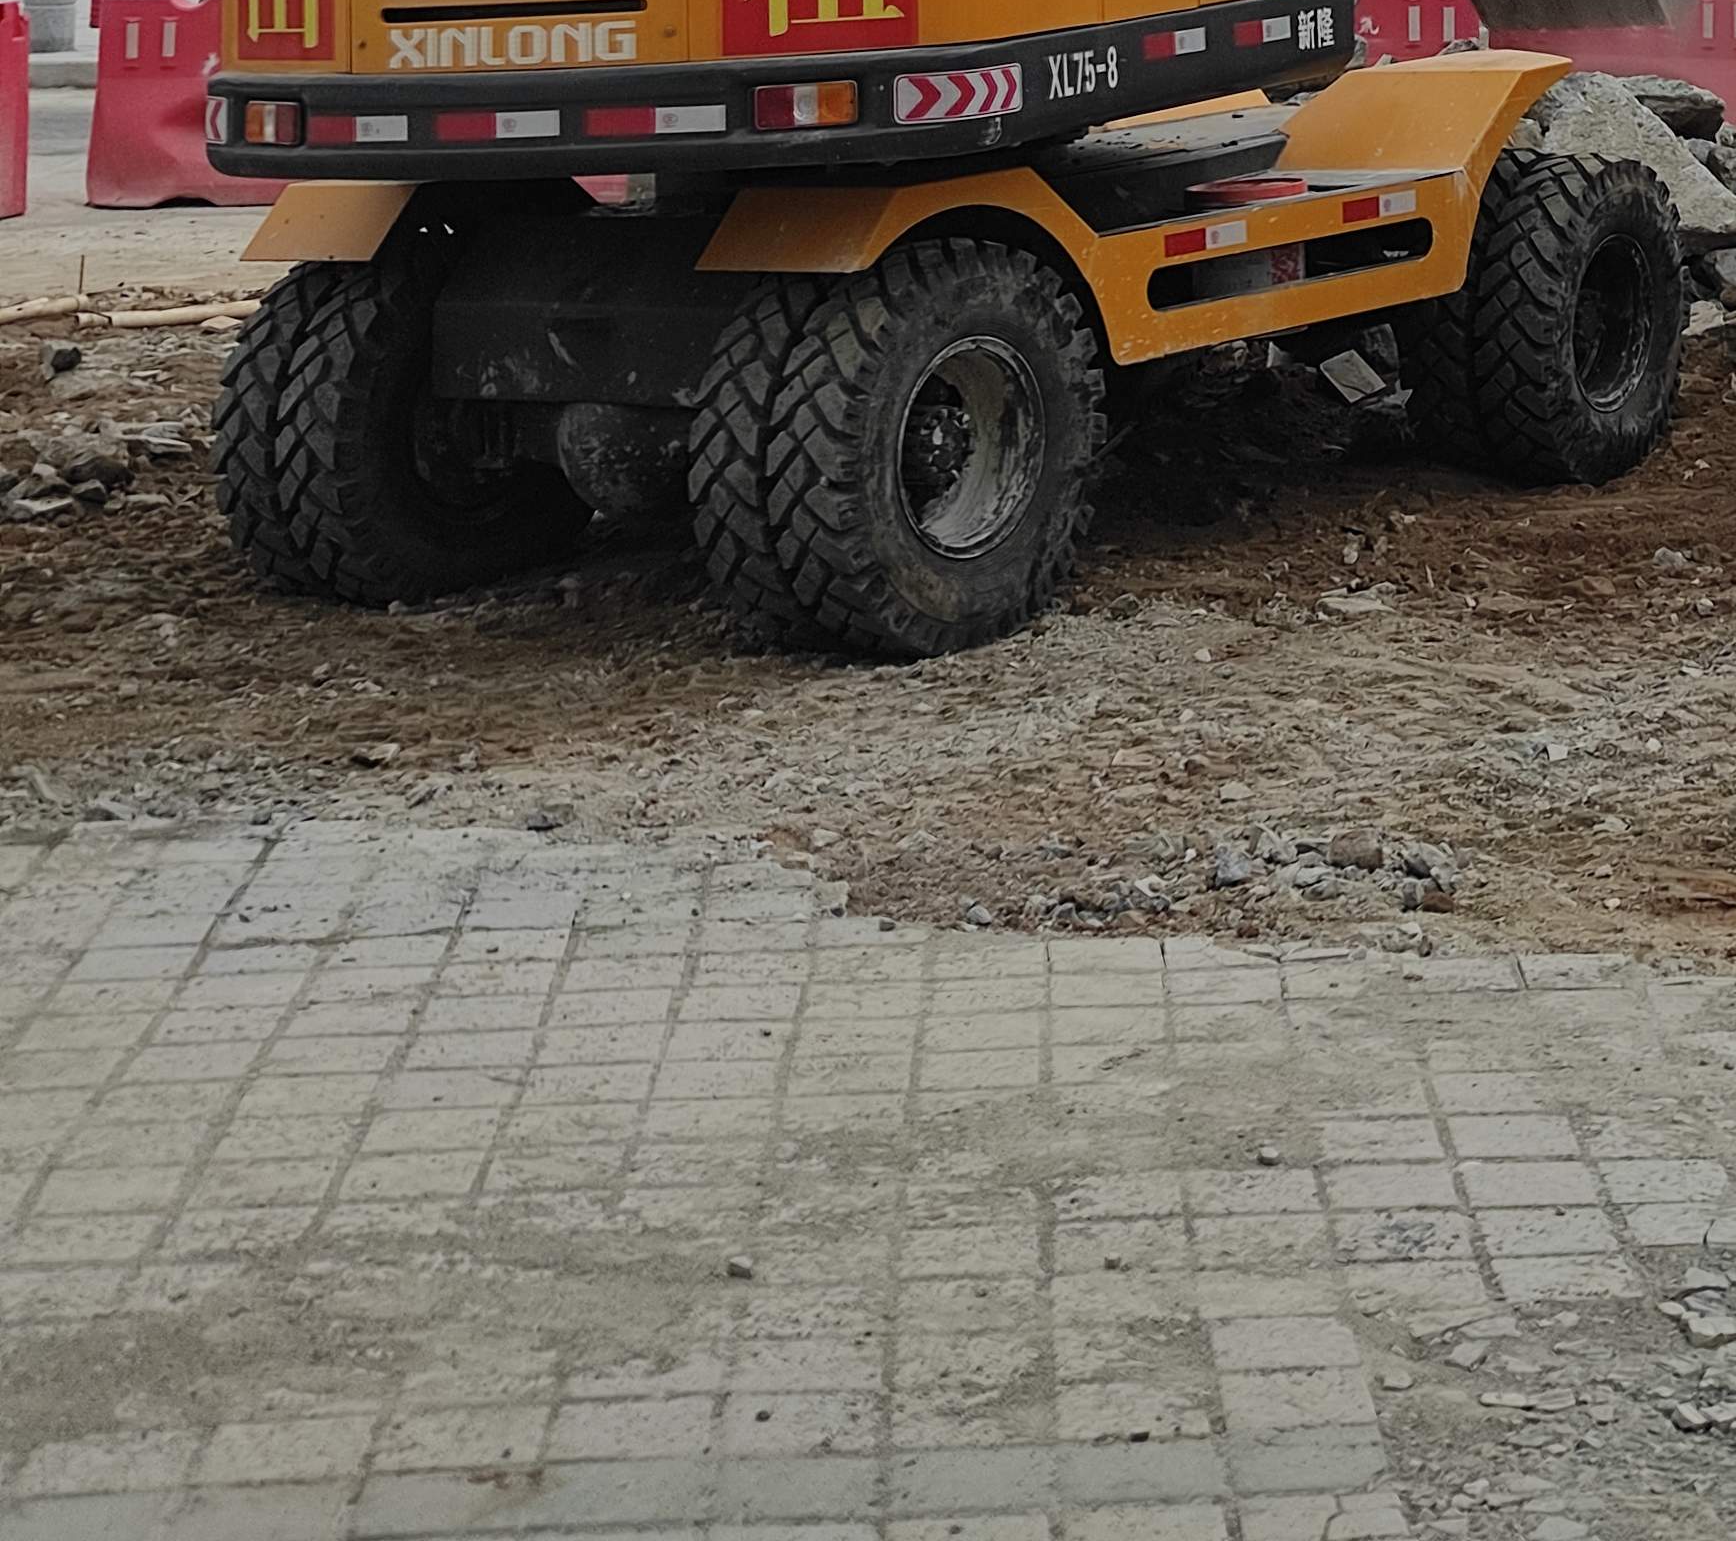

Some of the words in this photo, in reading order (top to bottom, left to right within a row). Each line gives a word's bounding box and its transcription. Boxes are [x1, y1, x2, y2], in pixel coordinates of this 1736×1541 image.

[388, 20, 637, 70] XINLONG
[1297, 7, 1335, 50] 新隆
[1049, 45, 1119, 100] XL75-8
